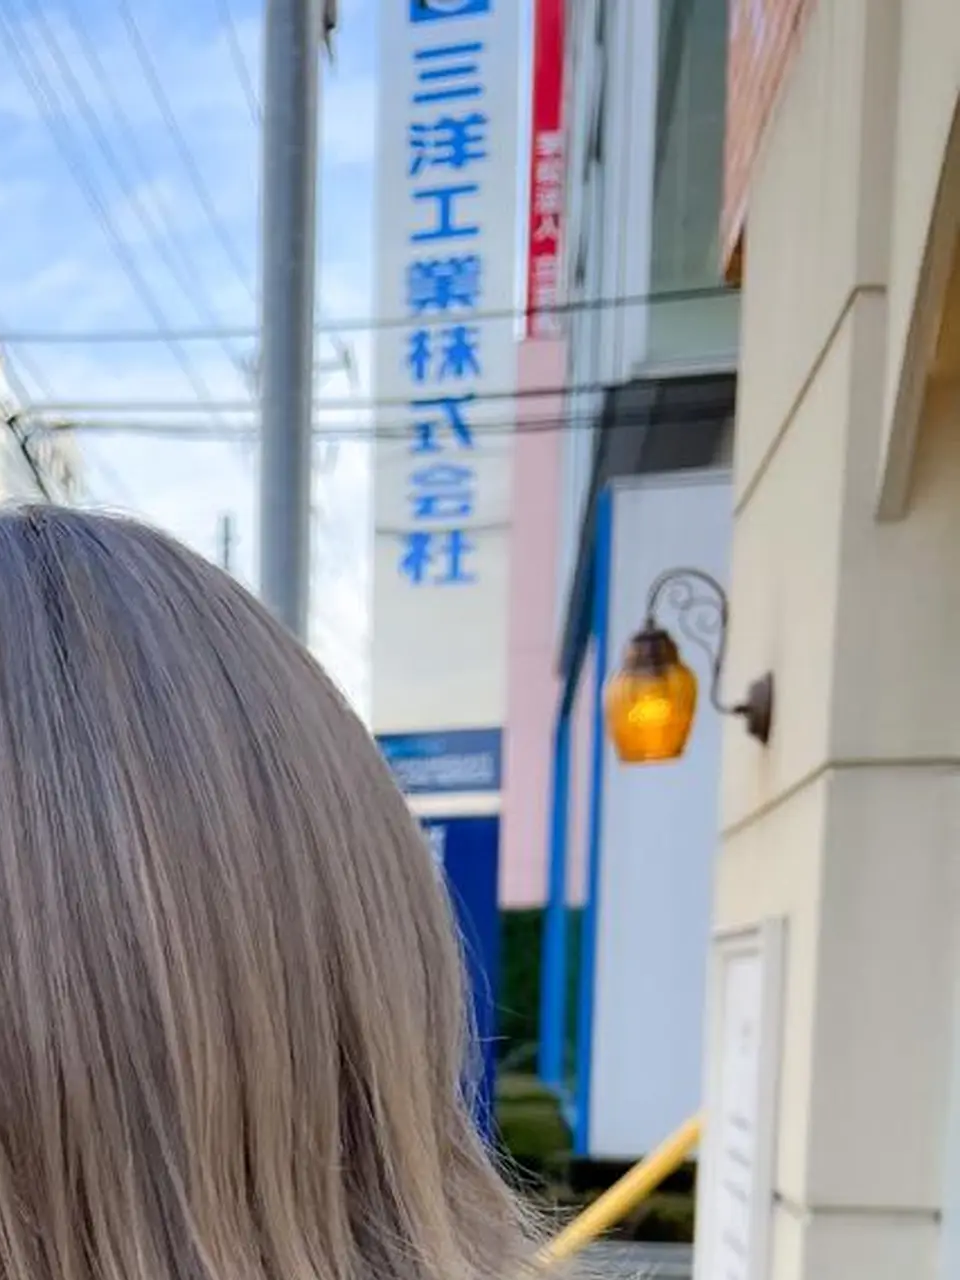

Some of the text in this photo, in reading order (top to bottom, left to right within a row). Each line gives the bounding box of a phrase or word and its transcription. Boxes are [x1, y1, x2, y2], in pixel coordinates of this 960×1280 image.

[399, 41, 487, 585] 三洋工業株式会社
